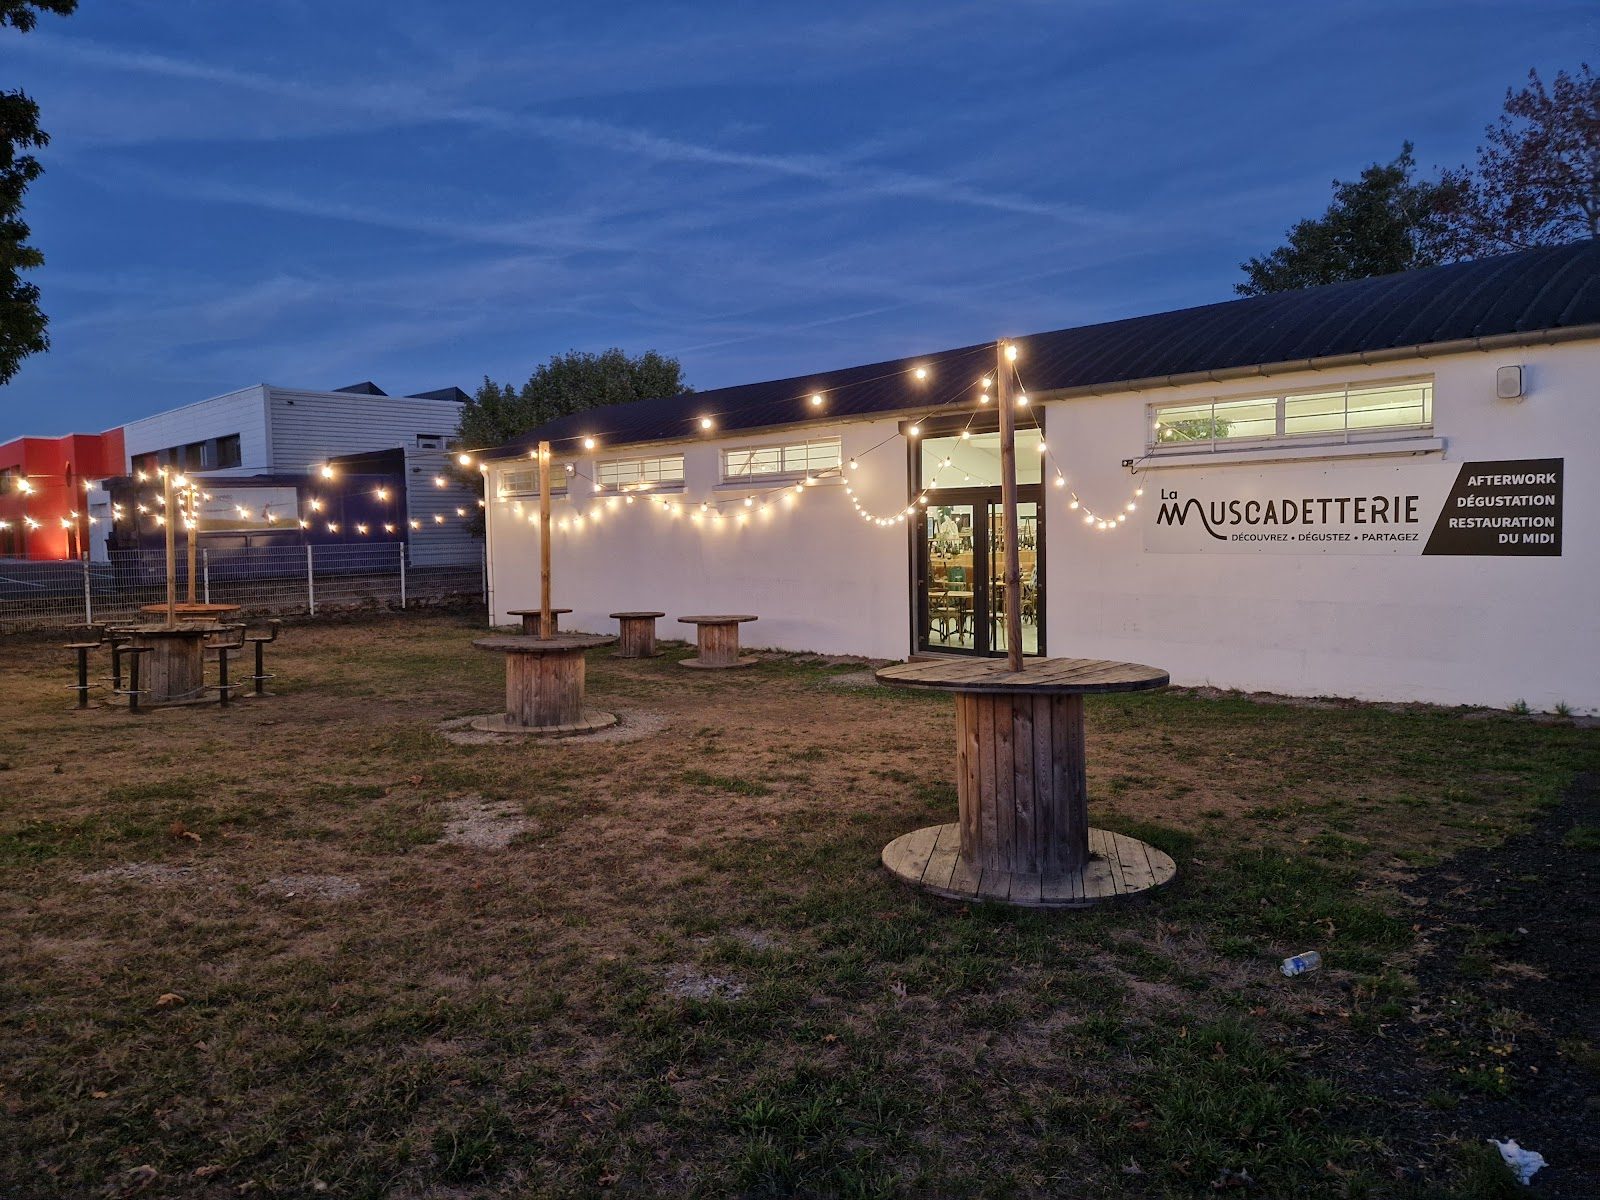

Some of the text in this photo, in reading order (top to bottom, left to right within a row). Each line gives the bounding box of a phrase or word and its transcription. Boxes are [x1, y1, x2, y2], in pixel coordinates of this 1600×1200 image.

[1467, 473, 1556, 486] AFTERWORK
[1161, 488, 1178, 500] La
[1457, 494, 1556, 508] DÉGUSTATION
[1156, 495, 1419, 540] MUSCADETTERIE
[1449, 516, 1555, 528] RESTAURATION
[1231, 531, 1419, 541] DÉCOUVREZ DÉGUSTEZ PARTAGEZ
[1498, 533, 1555, 544] DU MIDI
